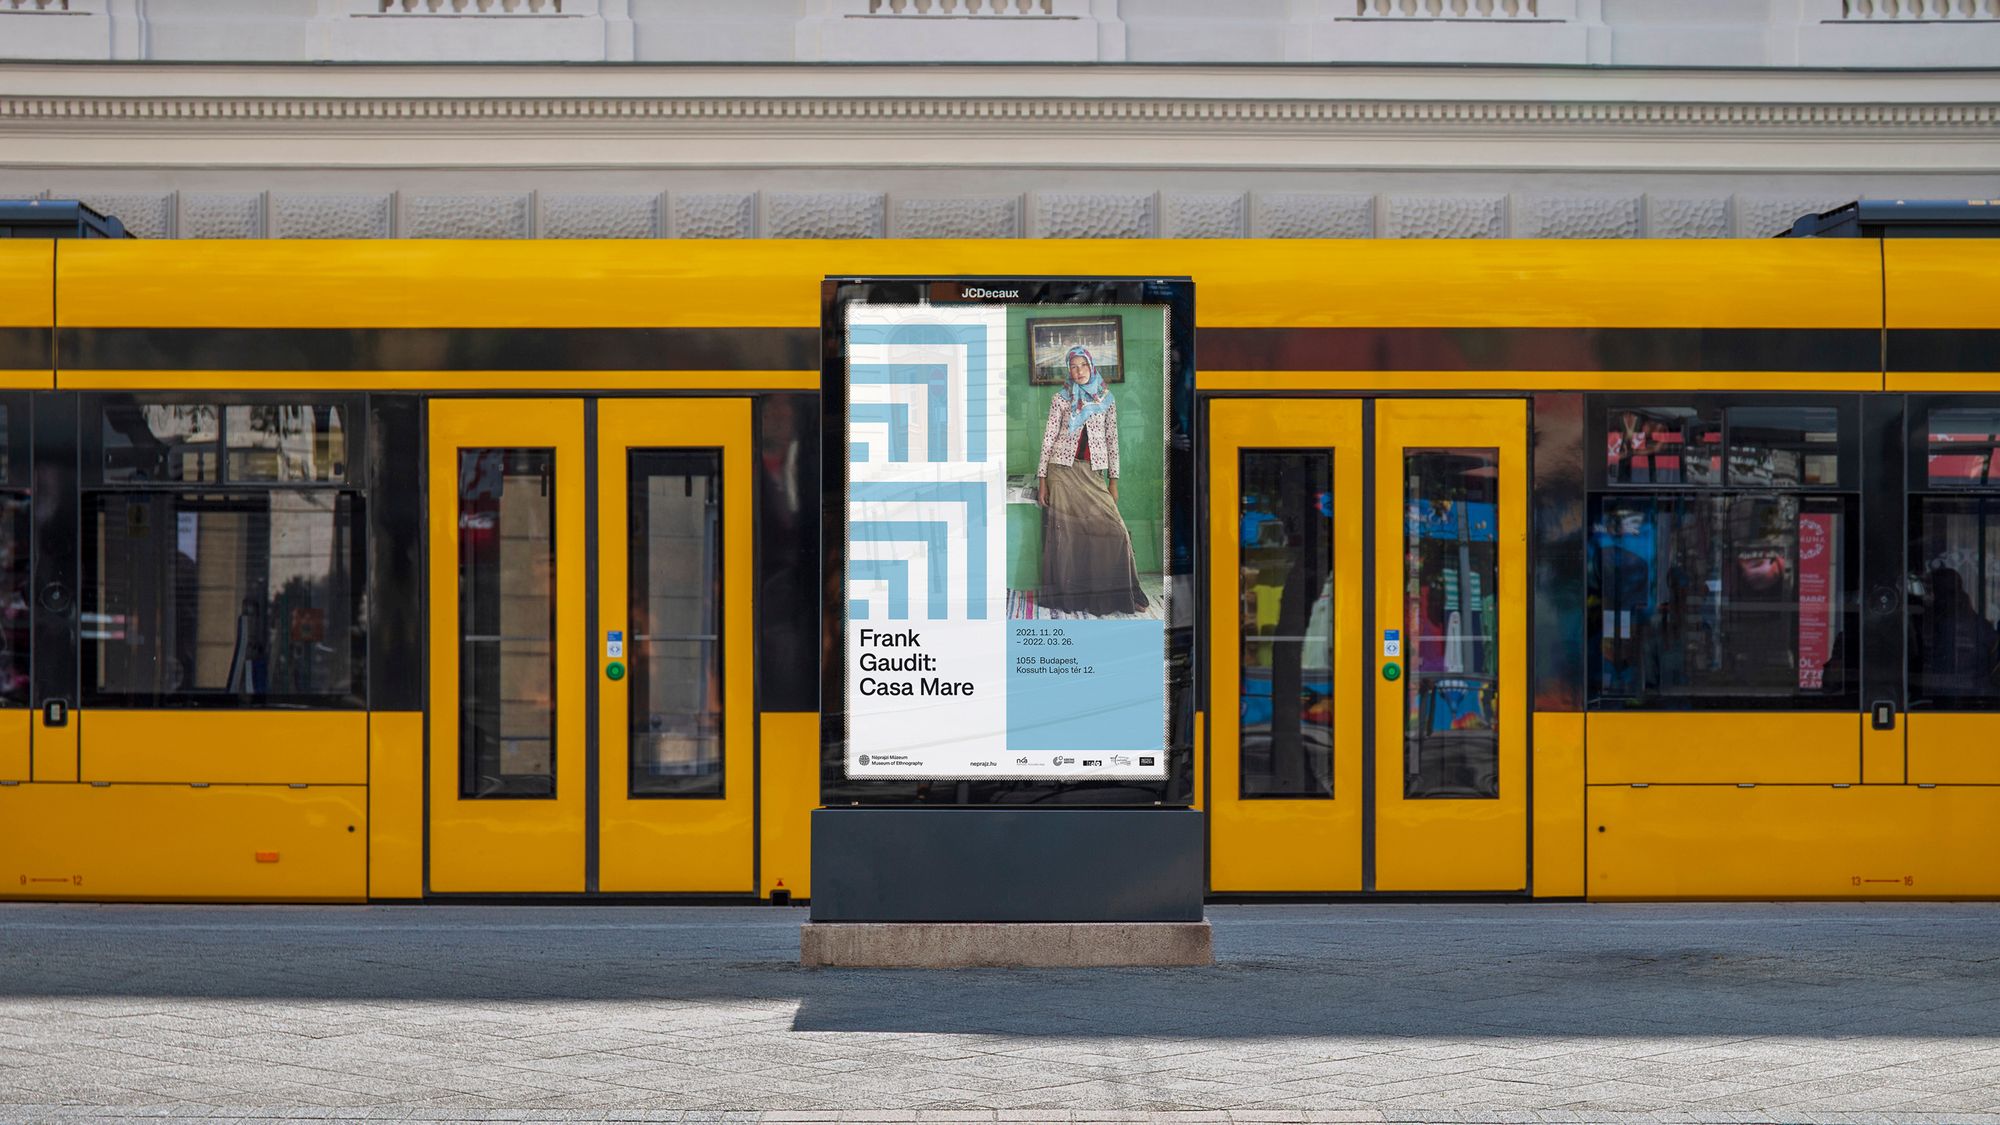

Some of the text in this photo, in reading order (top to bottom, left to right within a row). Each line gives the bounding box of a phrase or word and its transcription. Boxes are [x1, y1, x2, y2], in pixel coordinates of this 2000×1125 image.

[961, 287, 1019, 299] JCDecaux
[860, 628, 921, 648] Frank
[1016, 628, 1065, 636] 2021. 11. 20.
[1023, 638, 1045, 646] 2022.
[1047, 638, 1060, 646] 03.
[1062, 638, 1074, 646] 26.
[859, 652, 937, 672] Gaudit:
[1016, 656, 1079, 666] 1055 Budapest,
[1016, 666, 1095, 675] Kossuth Lajos tér 12.
[859, 677, 975, 697] Casa Mare
[970, 760, 998, 768] neprajz.hu
[73, 874, 83, 886] 12
[1851, 875, 1914, 887] 13 16
